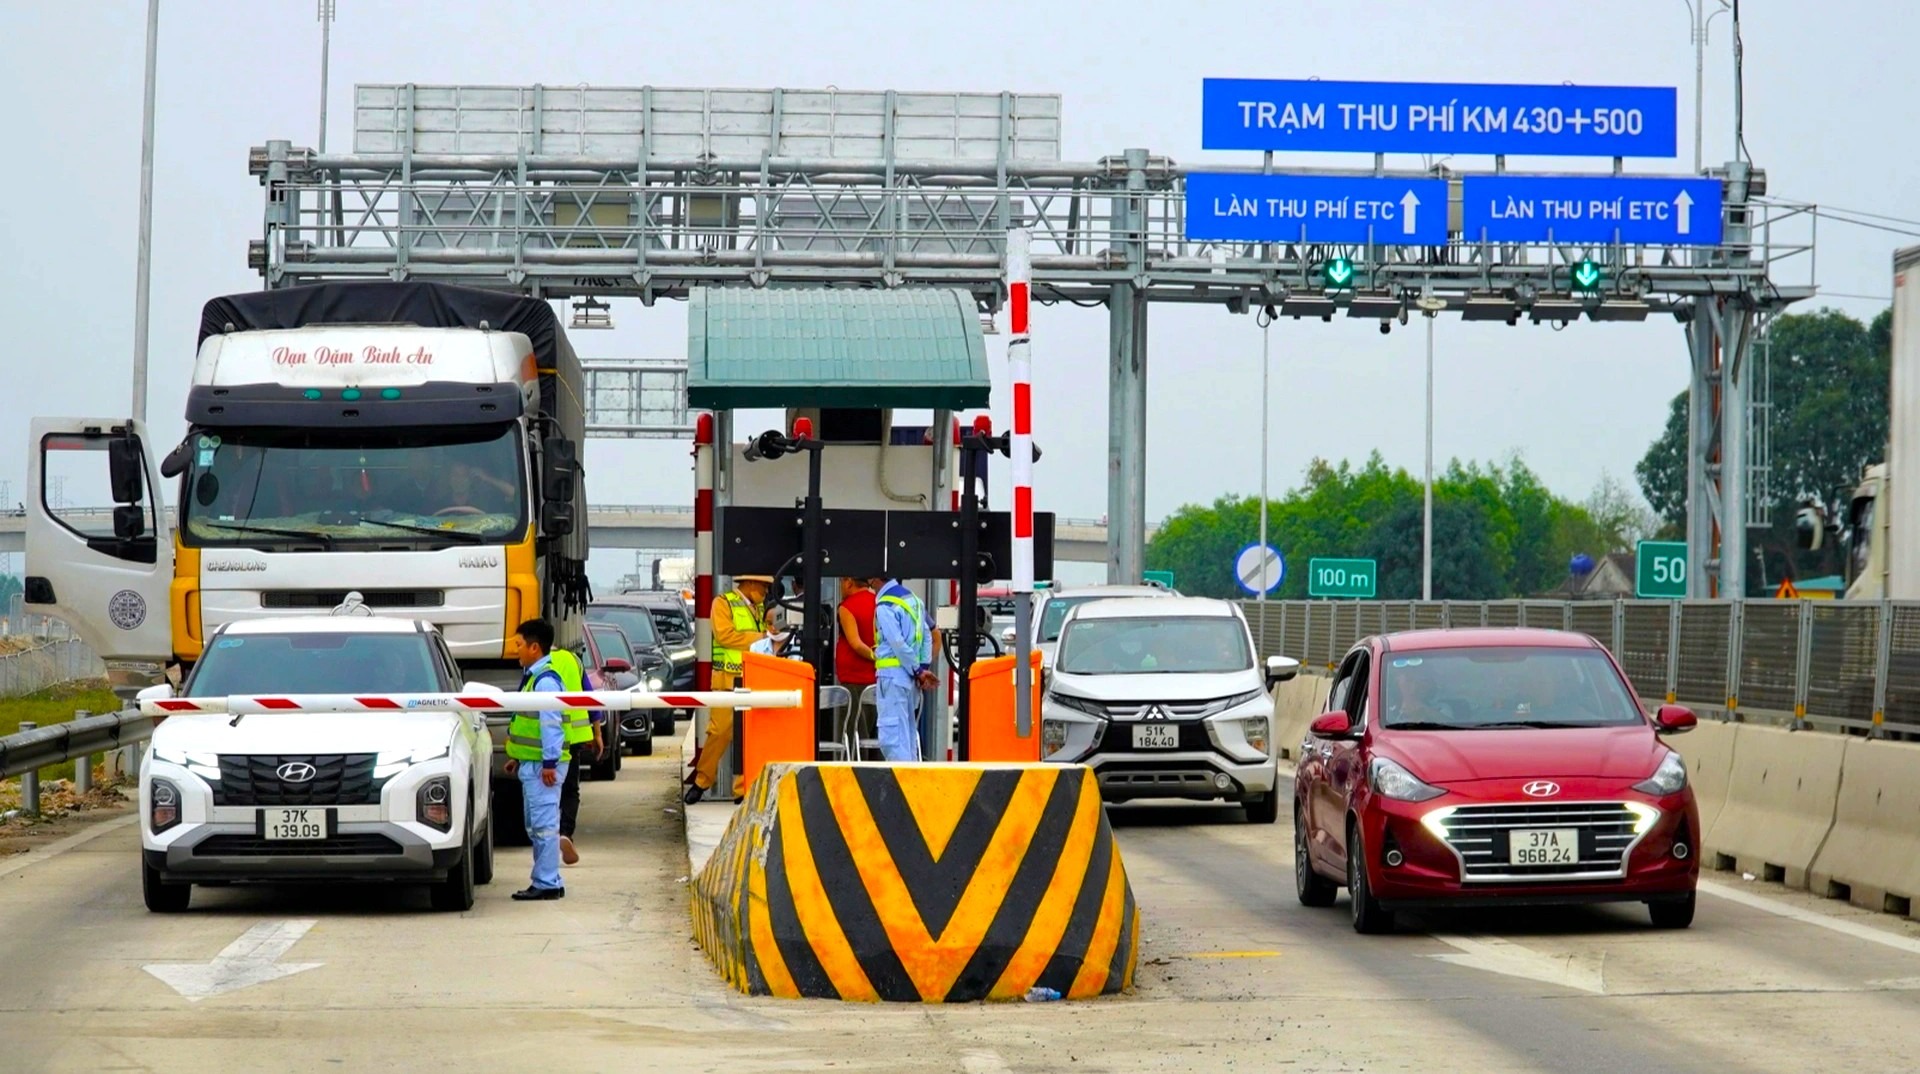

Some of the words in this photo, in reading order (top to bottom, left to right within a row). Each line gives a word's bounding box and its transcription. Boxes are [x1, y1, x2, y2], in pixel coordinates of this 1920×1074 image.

[1237, 101, 1325, 134] TRẠM
[1338, 103, 1398, 131] THU
[1408, 98, 1458, 132] PHÍ
[1462, 106, 1508, 133] KM
[1512, 107, 1643, 135] 430+500
[1214, 193, 1258, 217] LÀN
[1266, 199, 1307, 218] THU
[1314, 196, 1350, 219] PHÍ
[1354, 201, 1395, 220] ETC
[1491, 195, 1534, 219] LÀN
[1542, 200, 1582, 219] THU
[1589, 196, 1624, 220] PHÍ
[1629, 201, 1669, 220] ETC
[272, 346, 308, 368] Vạn
[313, 346, 355, 368] Dặm
[362, 345, 402, 365] Bình
[406, 346, 435, 365] An
[1317, 568, 1346, 586] 100
[1350, 574, 1368, 587] m
[1653, 556, 1686, 583] 50
[1145, 725, 1166, 736] 51K
[1139, 736, 1175, 747] 184.40
[282, 810, 308, 823] 37K
[273, 824, 320, 838] 139.09
[1530, 832, 1559, 847] 37A
[1518, 848, 1571, 863] 968.24
